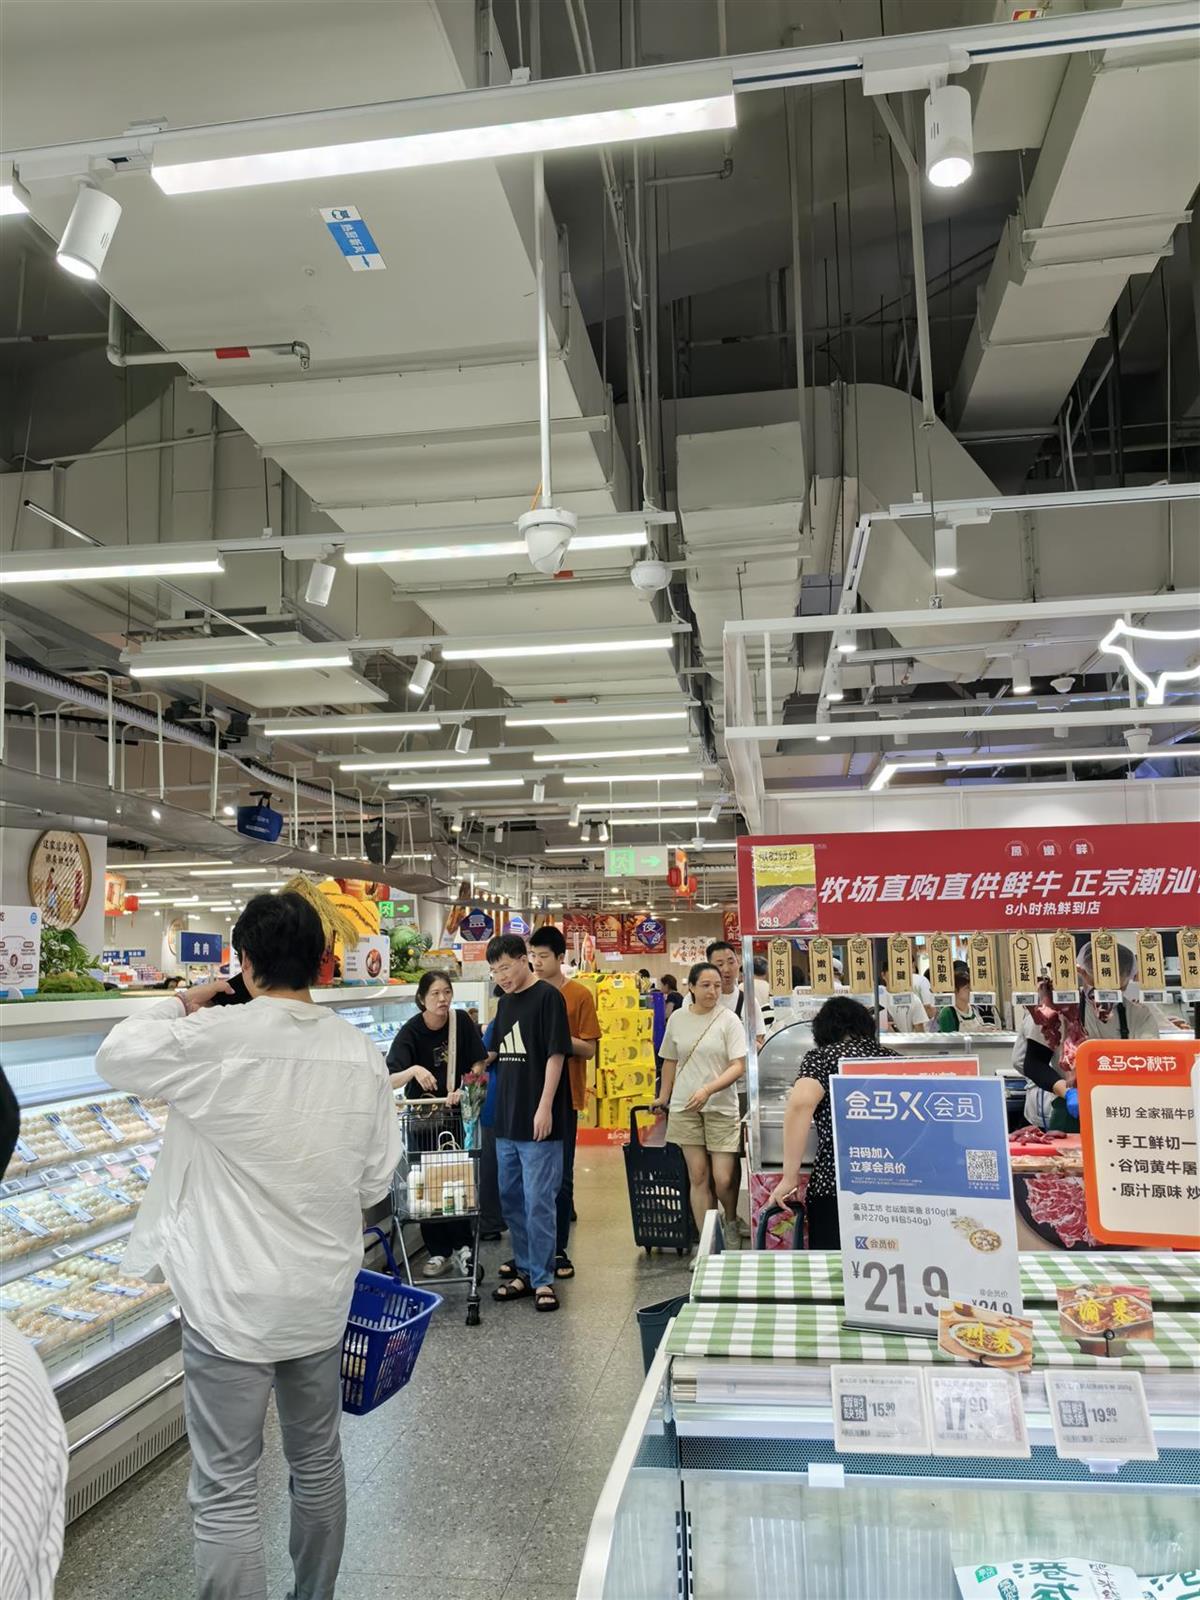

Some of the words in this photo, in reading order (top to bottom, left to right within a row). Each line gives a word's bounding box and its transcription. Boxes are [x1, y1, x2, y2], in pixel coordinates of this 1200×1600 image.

[818, 870, 1063, 904] 牧场直购直供鲜牛
[1067, 866, 1200, 898] 正宗潮汕
[1005, 901, 1101, 916] 8小时热鲜到店
[1145, 953, 1158, 977] 吊龙
[1187, 952, 1199, 976] 雪花
[776, 959, 786, 987] 牛肉丸
[1097, 1055, 1177, 1072] 盒马中秋节
[934, 1096, 976, 1118] 会员
[1105, 1106, 1131, 1119] 鲜切
[1116, 1135, 1197, 1151] 手工鲜切一
[849, 1146, 894, 1159] 扫码加入
[850, 1161, 906, 1175] 立享会员价
[1118, 1158, 1198, 1176] 谷饲黄牛屠
[1120, 1183, 1183, 1200] 原汁原味
[870, 1239, 897, 1249] 会员价
